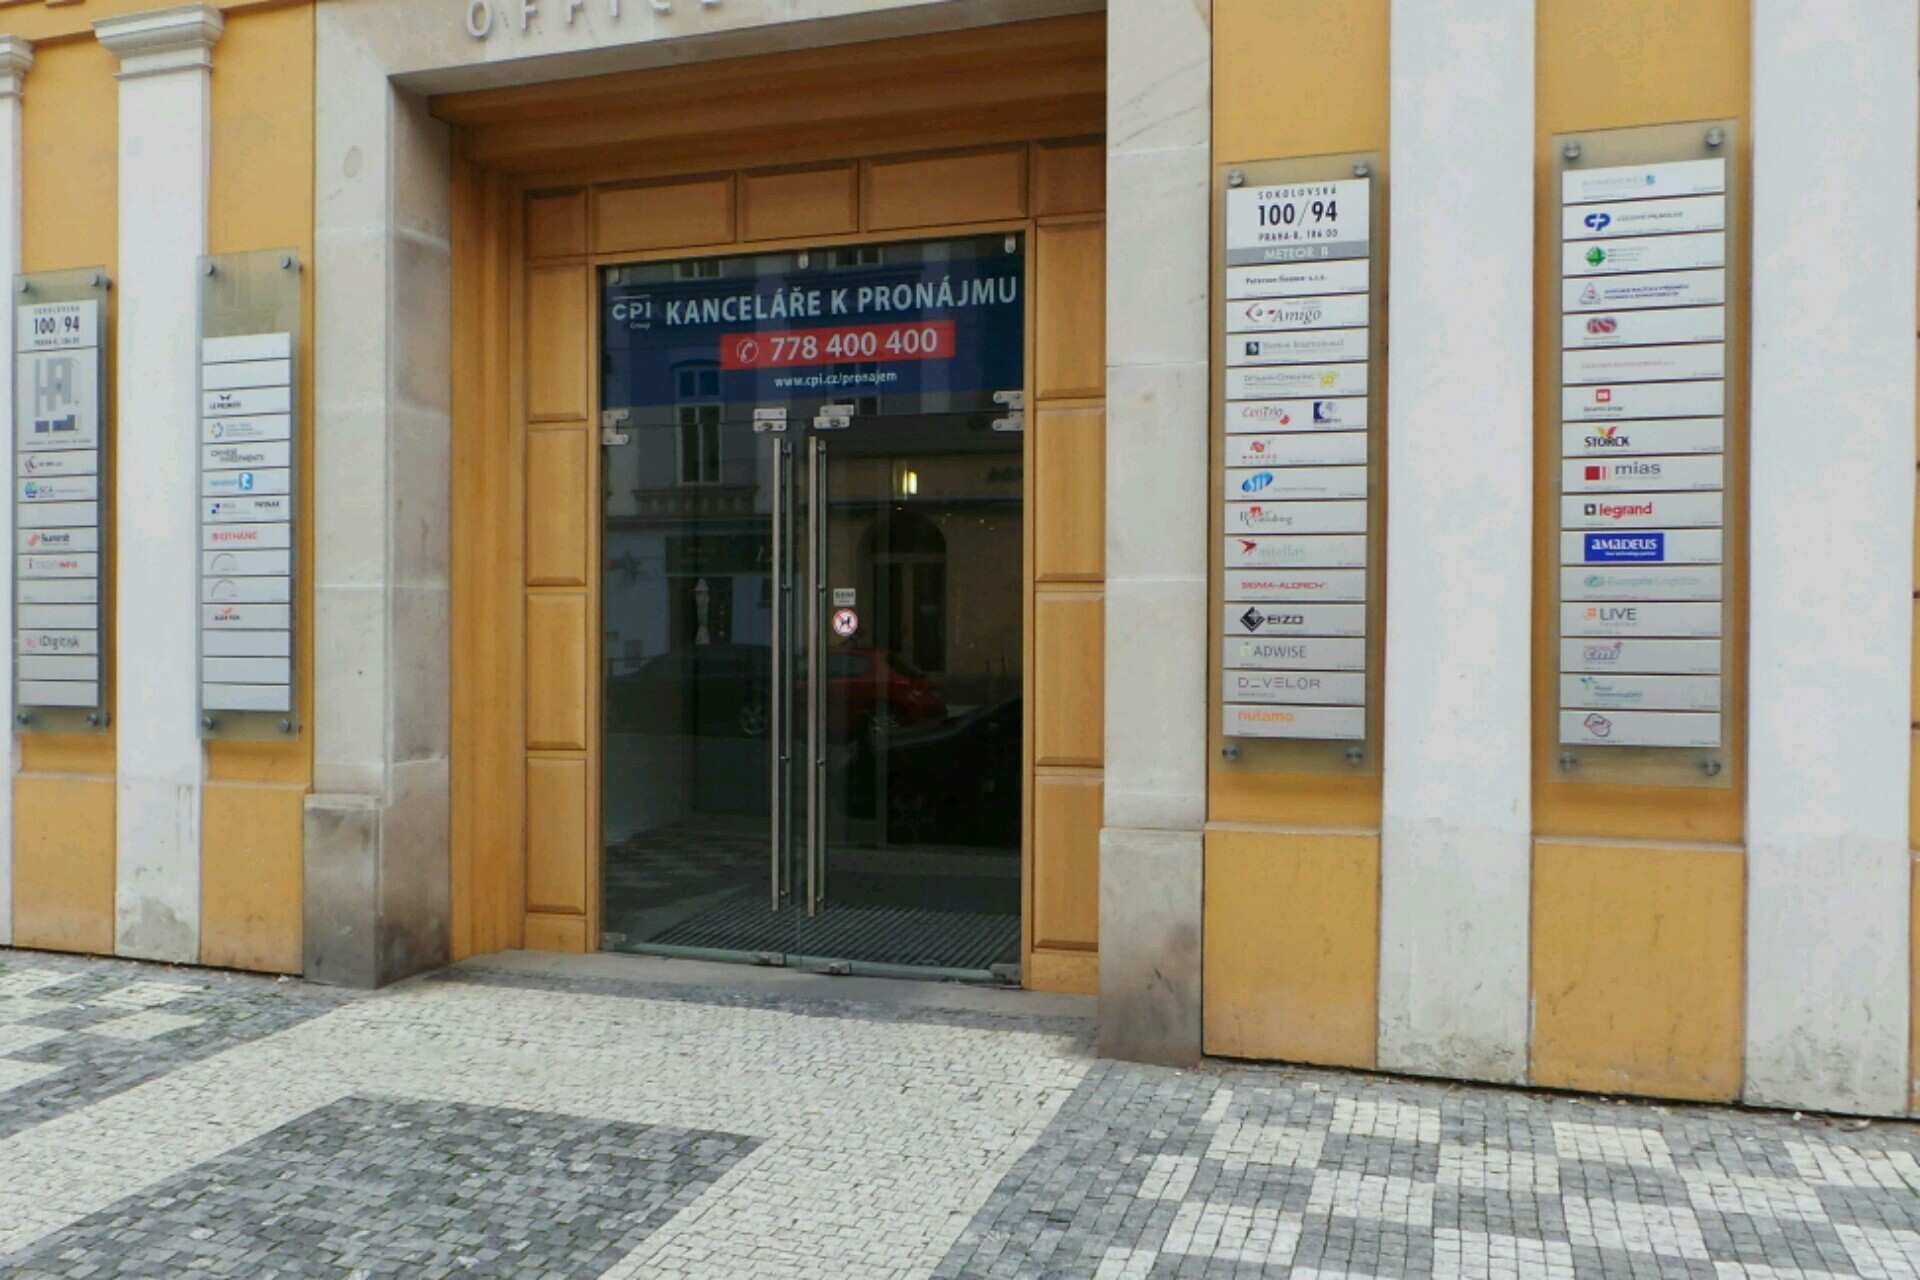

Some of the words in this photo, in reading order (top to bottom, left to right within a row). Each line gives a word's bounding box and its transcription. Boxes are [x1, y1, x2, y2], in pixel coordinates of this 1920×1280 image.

[1258, 184, 1337, 200] SOKOLOVSKÁ
[1264, 247, 1314, 260] METEOR
[666, 286, 821, 326] KANCELÁŘE
[831, 288, 849, 315] K
[858, 275, 1017, 312] PRONÁJMU
[612, 301, 651, 321] CPI
[1273, 308, 1322, 324] Amigo
[770, 335, 818, 362] 778
[826, 331, 877, 358] 400
[885, 327, 938, 355] 400
[774, 370, 897, 388] www.cpi.cz/pronajem
[1584, 436, 1630, 448] STORCK
[1615, 461, 1661, 475] mias
[1599, 501, 1653, 519] legrand
[1267, 615, 1304, 625] EIZO
[1600, 608, 1637, 621] LIVE
[1254, 645, 1307, 658] ADWISE
[1238, 710, 1295, 722] nutamo
